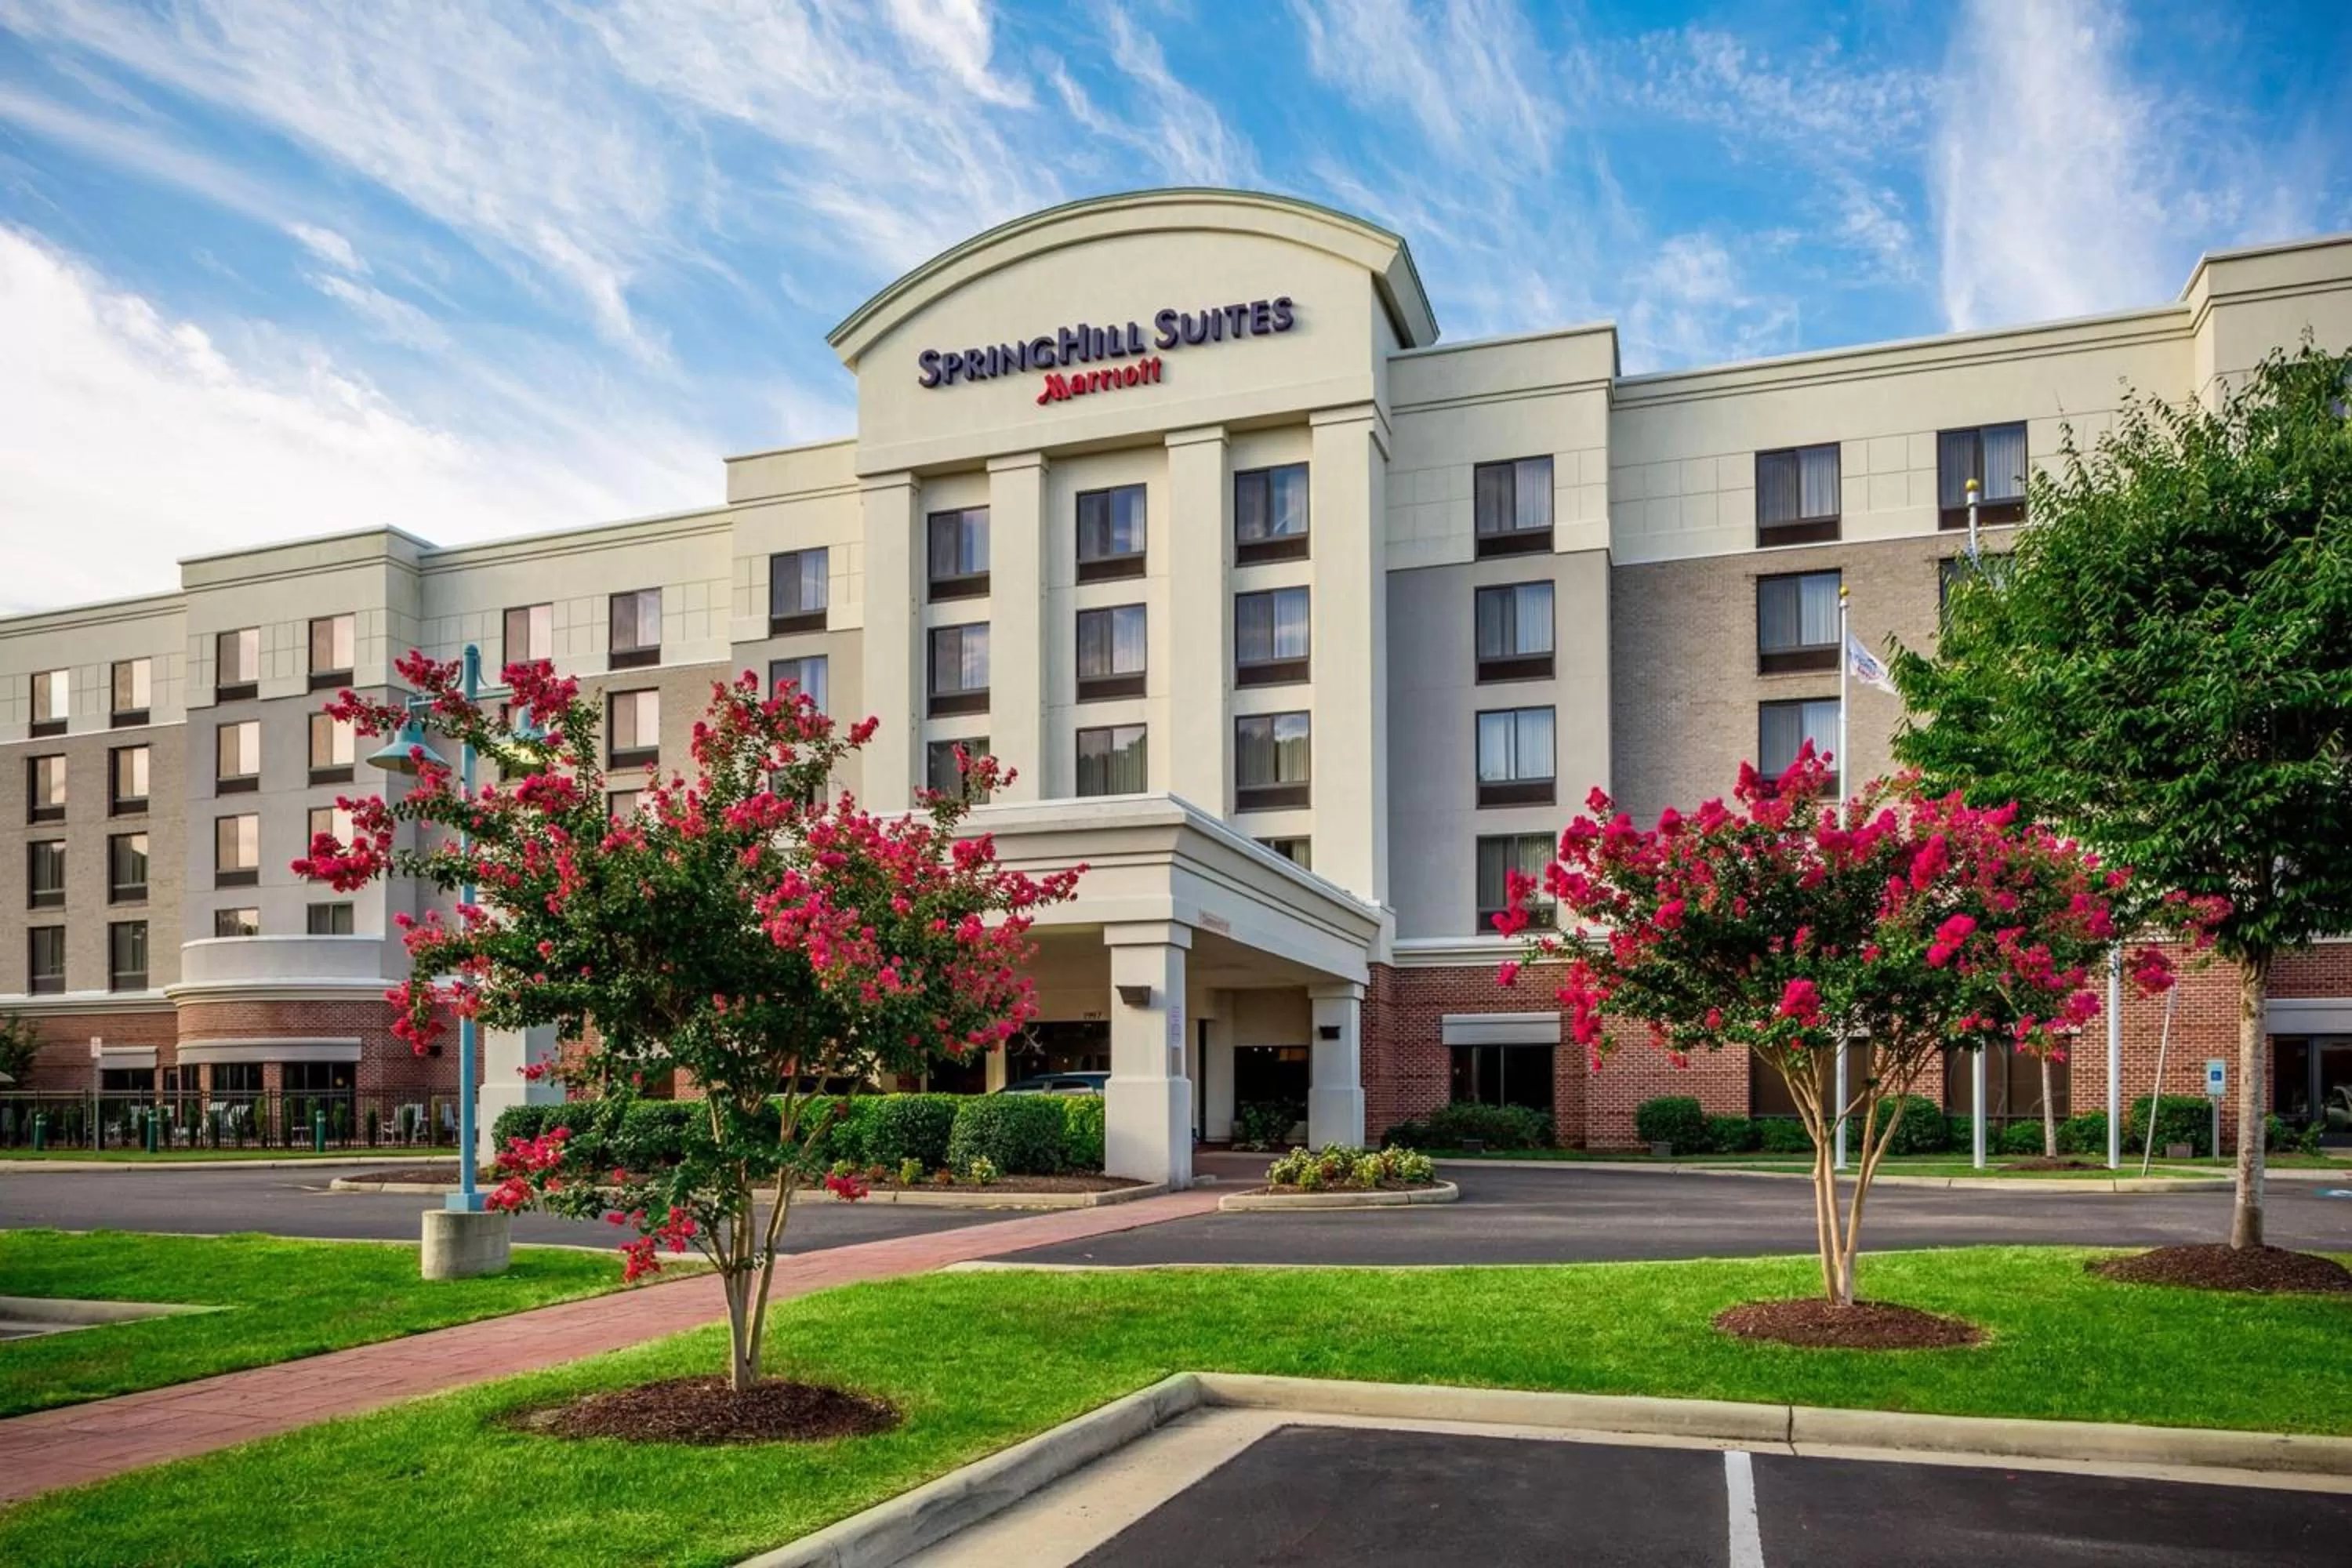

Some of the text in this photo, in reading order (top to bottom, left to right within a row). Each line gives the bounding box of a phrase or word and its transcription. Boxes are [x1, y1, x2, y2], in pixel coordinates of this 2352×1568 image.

[919, 296, 1294, 387] SPRINGHILL SUITES
[1036, 357, 1161, 405] Marriott
